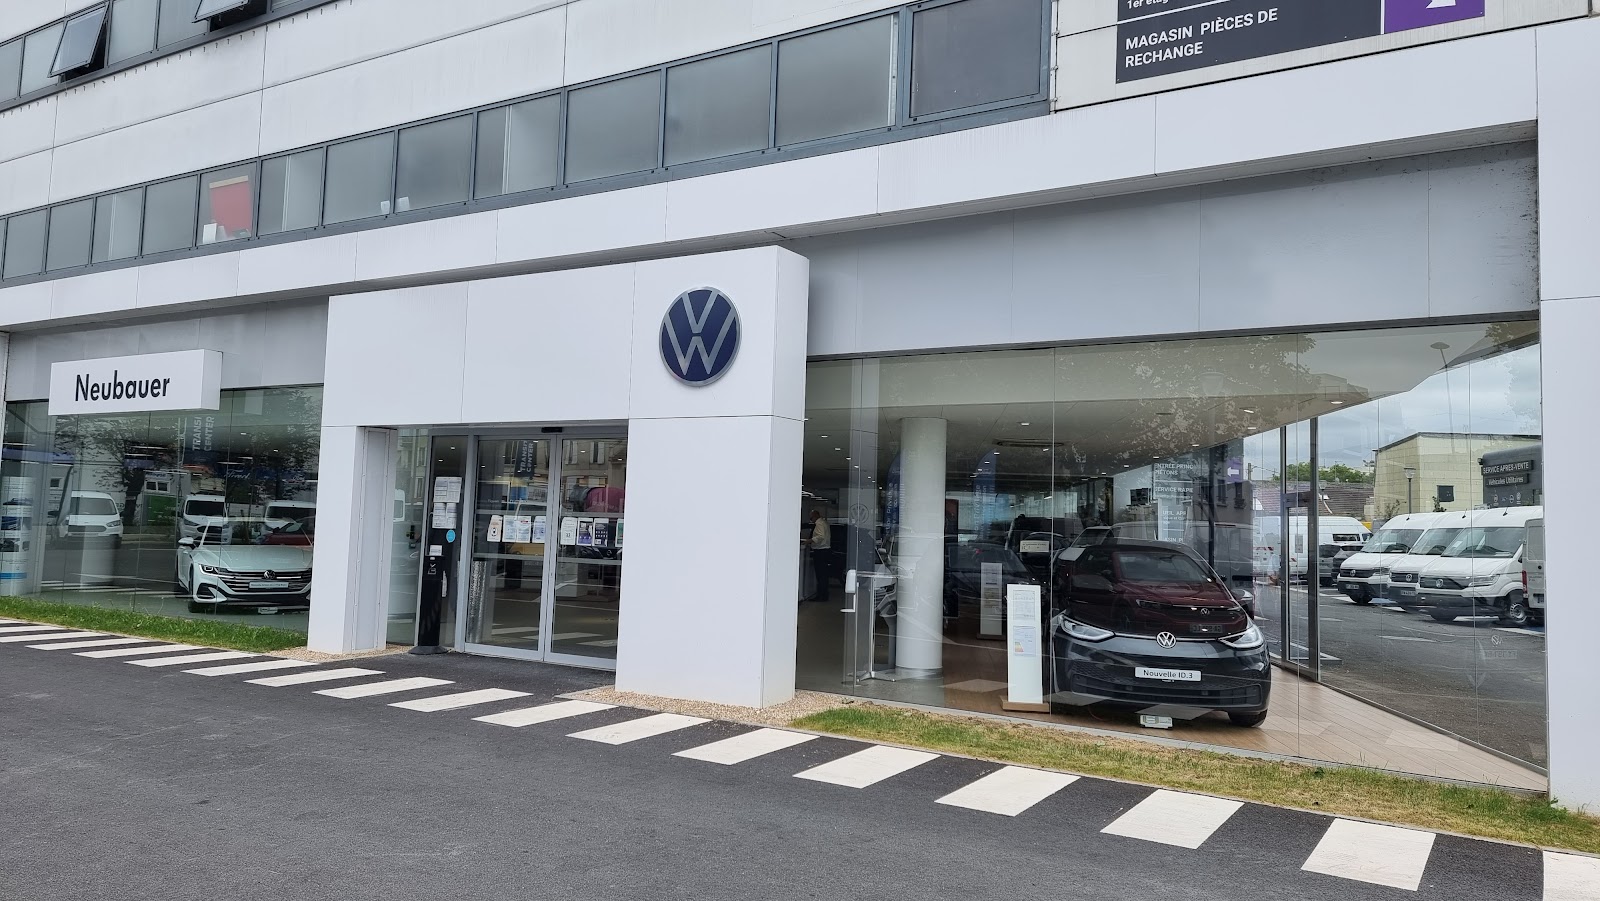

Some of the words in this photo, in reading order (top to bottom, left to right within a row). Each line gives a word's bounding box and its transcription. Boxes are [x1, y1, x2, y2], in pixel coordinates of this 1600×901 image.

[1125, 25, 1193, 51] MAGASIN
[1200, 13, 1254, 36] PIÈCES
[1257, 8, 1278, 24] DE
[1125, 41, 1203, 68] RECHANGE
[659, 286, 742, 387] VW
[75, 369, 170, 402] Neubauer
[204, 416, 215, 452] CENTER
[526, 442, 534, 473] CNTER
[1483, 465, 1500, 474] SERVICE
[1157, 631, 1176, 649] VW
[1143, 669, 1177, 678] Nouvelle
[1178, 671, 1193, 679] ID.3
